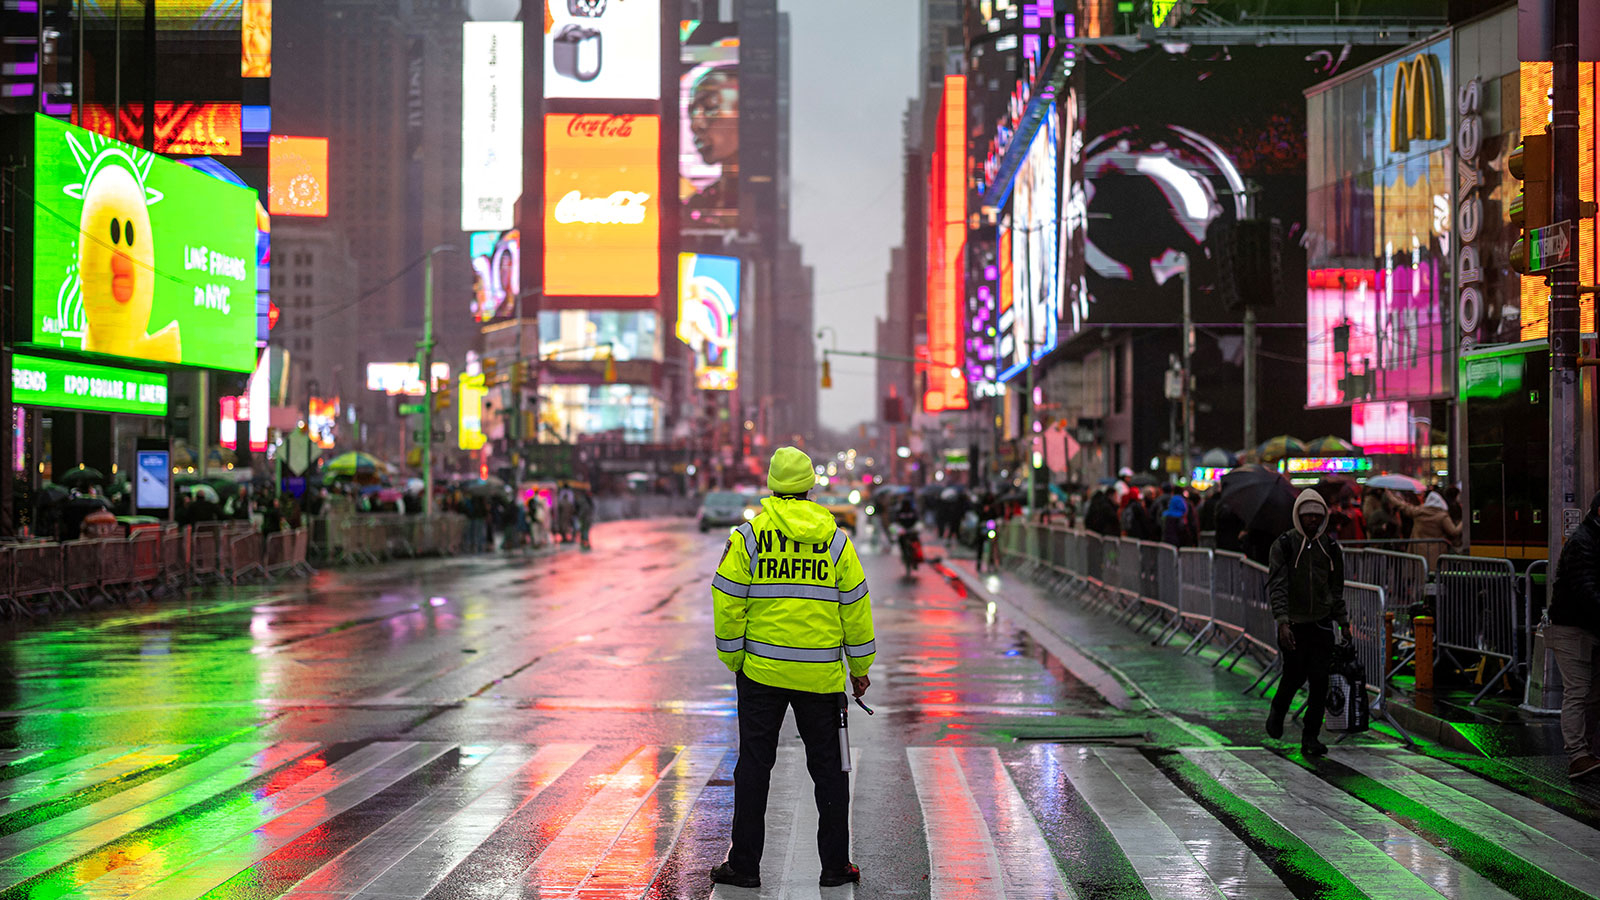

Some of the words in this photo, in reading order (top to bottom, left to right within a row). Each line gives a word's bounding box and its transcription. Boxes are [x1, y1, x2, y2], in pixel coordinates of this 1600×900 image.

[184, 244, 209, 271] LINE
[209, 250, 246, 281] FRIENDS
[205, 283, 230, 315] NYC
[64, 374, 89, 396] KPOP
[90, 377, 124, 399] SQUARE
[126, 381, 137, 400] BY
[758, 558, 829, 580] TRAFFIC
